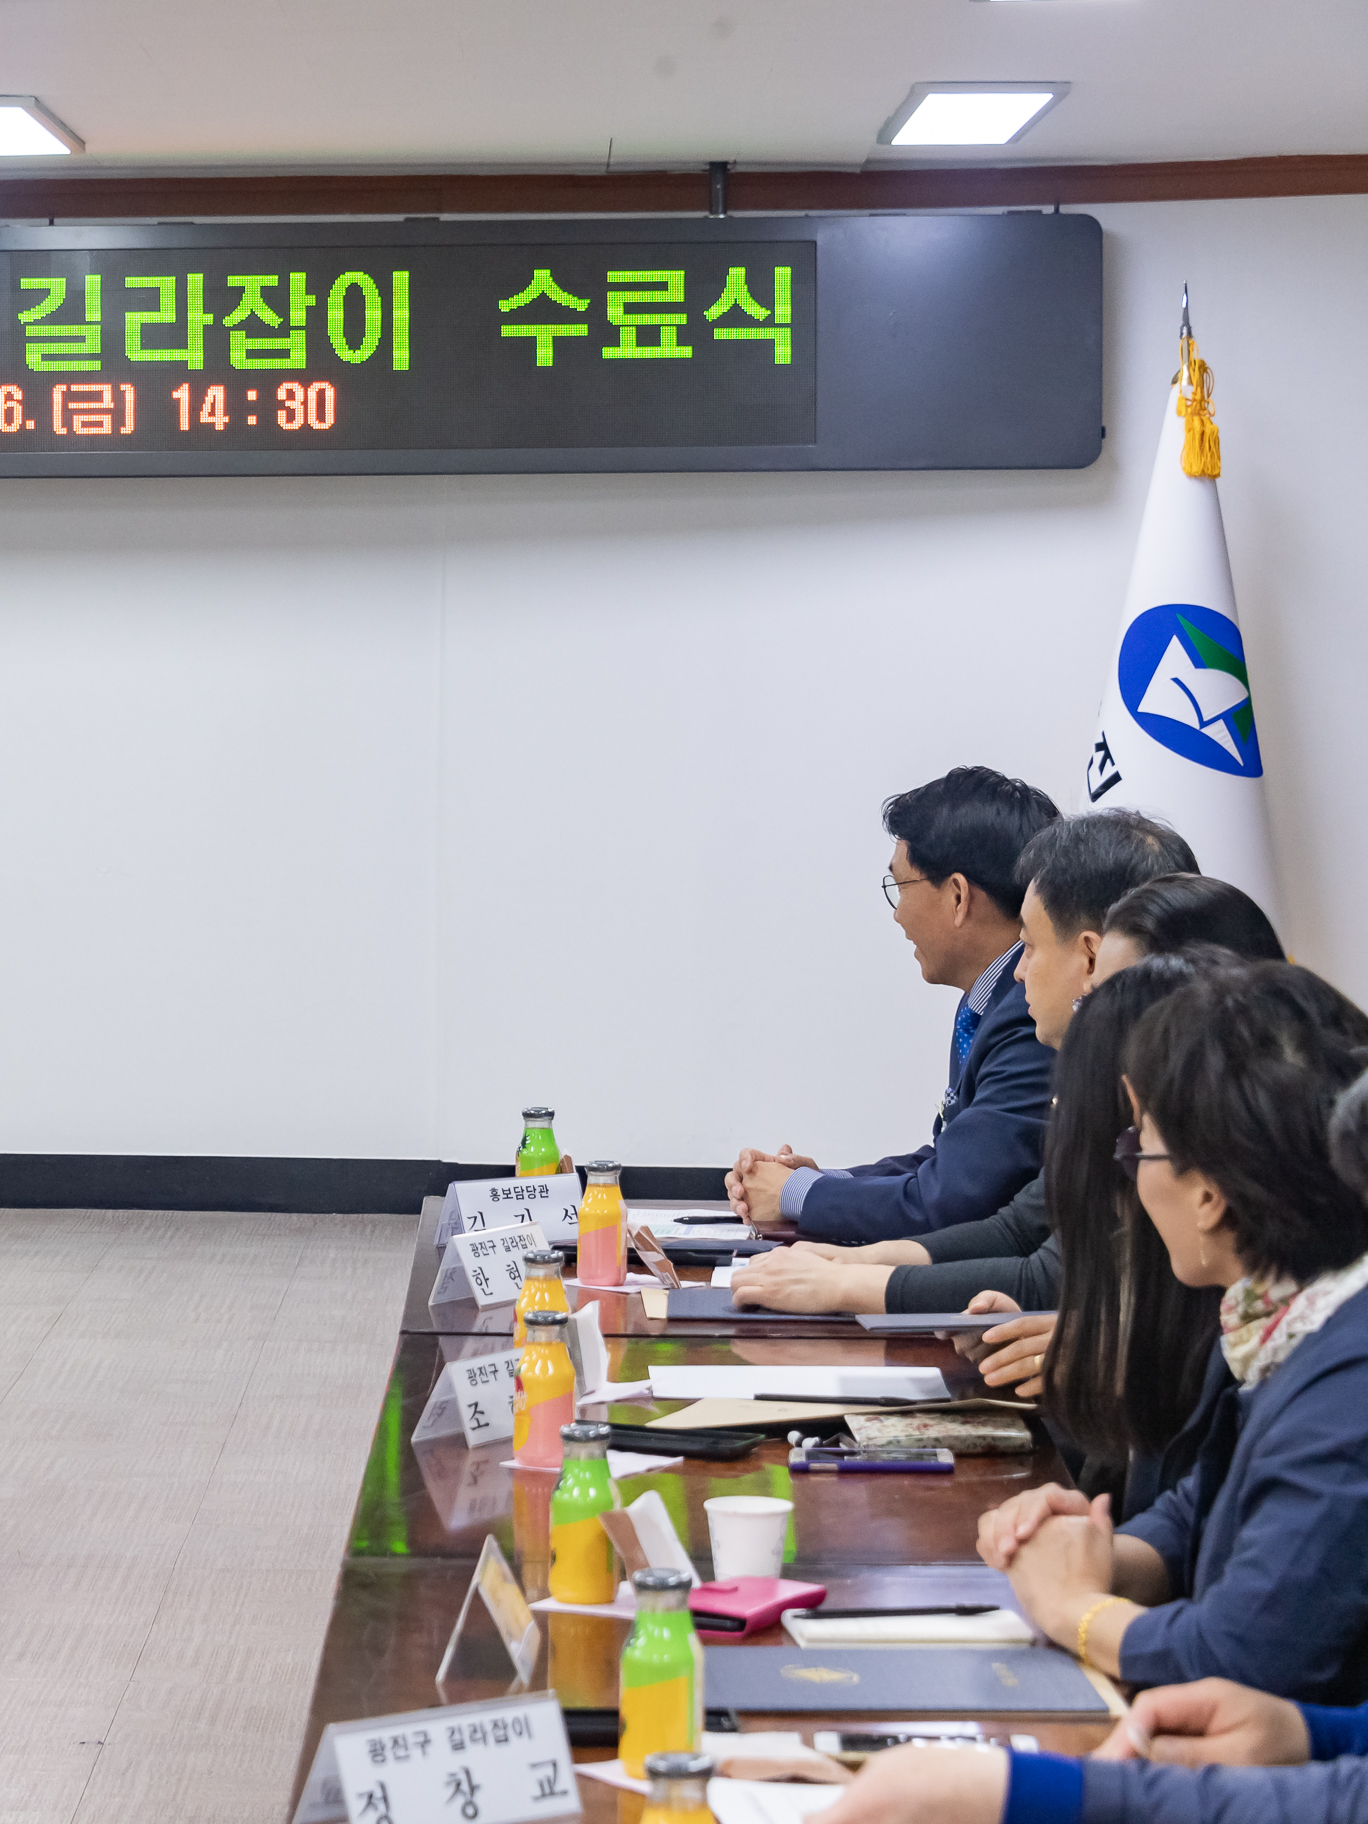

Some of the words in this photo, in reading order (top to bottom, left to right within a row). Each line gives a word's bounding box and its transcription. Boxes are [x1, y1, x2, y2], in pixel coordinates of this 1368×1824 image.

[18, 270, 410, 372] 길라잡이
[498, 265, 792, 367] 수료식
[489, 1183, 550, 1203] 홍보담당관
[469, 1239, 498, 1258] 광진구
[499, 1232, 538, 1253] 길라잡이
[465, 1363, 499, 1387] 광진구
[366, 1729, 433, 1765] 광진구
[445, 1712, 533, 1752] 길라잡이
